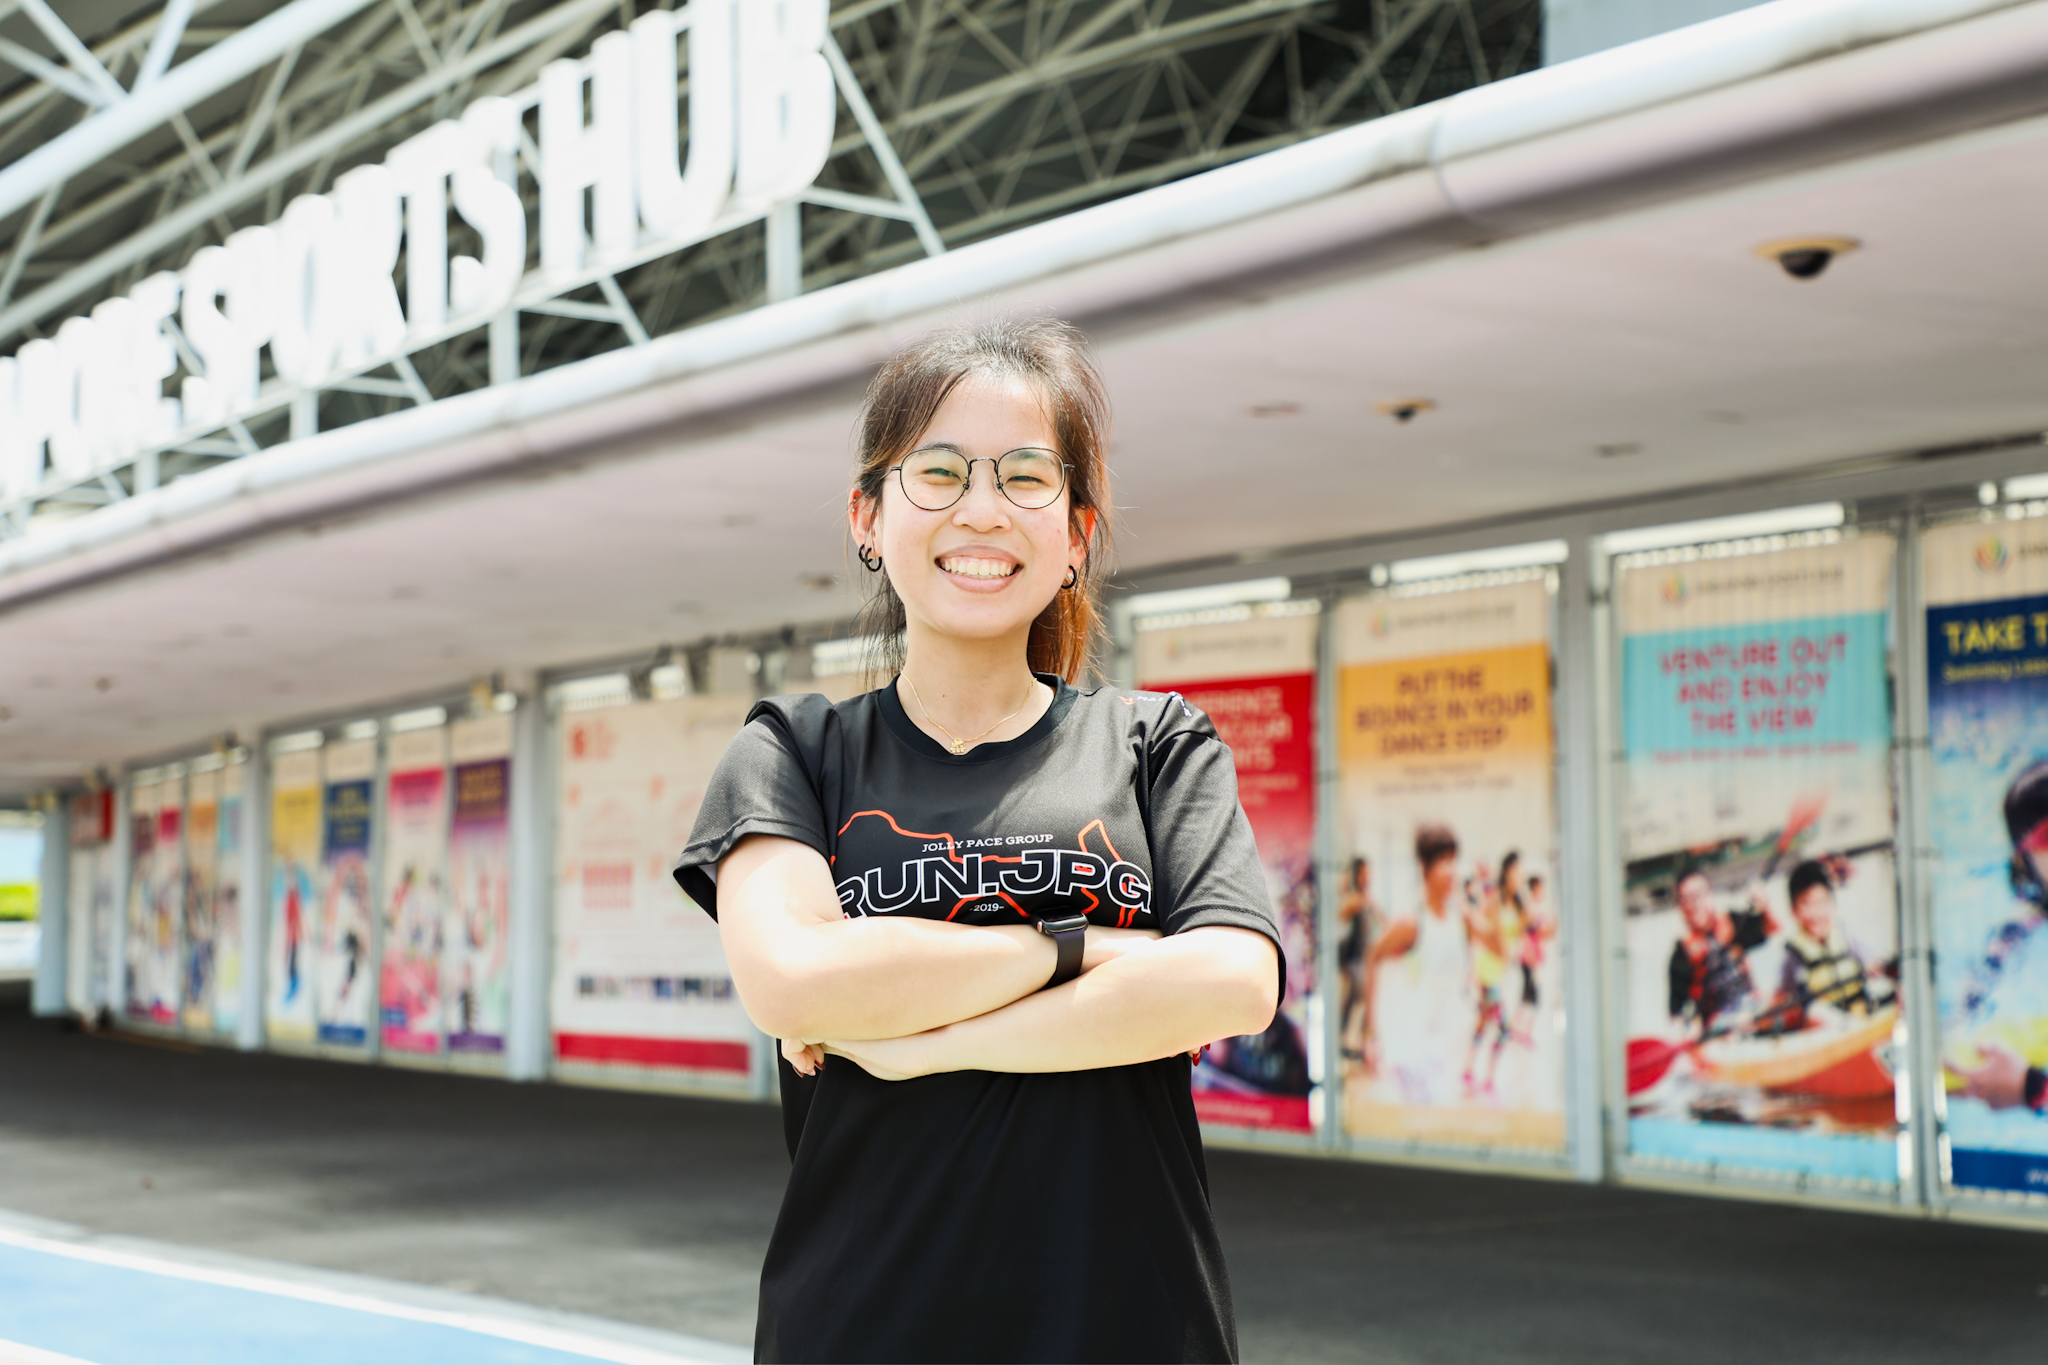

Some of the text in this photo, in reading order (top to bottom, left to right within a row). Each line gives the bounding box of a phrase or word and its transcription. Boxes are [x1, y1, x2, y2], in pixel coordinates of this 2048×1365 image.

[181, 96, 526, 426] SPORTS
[539, 0, 837, 278] HUB
[1941, 614, 2026, 655] TAKE
[1658, 632, 1847, 677] VENTURE OUT
[1397, 665, 1485, 695] PUT THE
[1678, 669, 1831, 706] AND ENJOY
[1355, 688, 1536, 734] BOUNCE IN YOUR
[1690, 702, 1818, 737] THE VIEW
[1379, 723, 1510, 760] DANCE STEP
[922, 834, 1054, 852] JOLLY PACE GROUP
[836, 848, 1152, 920] RUN.JPG
